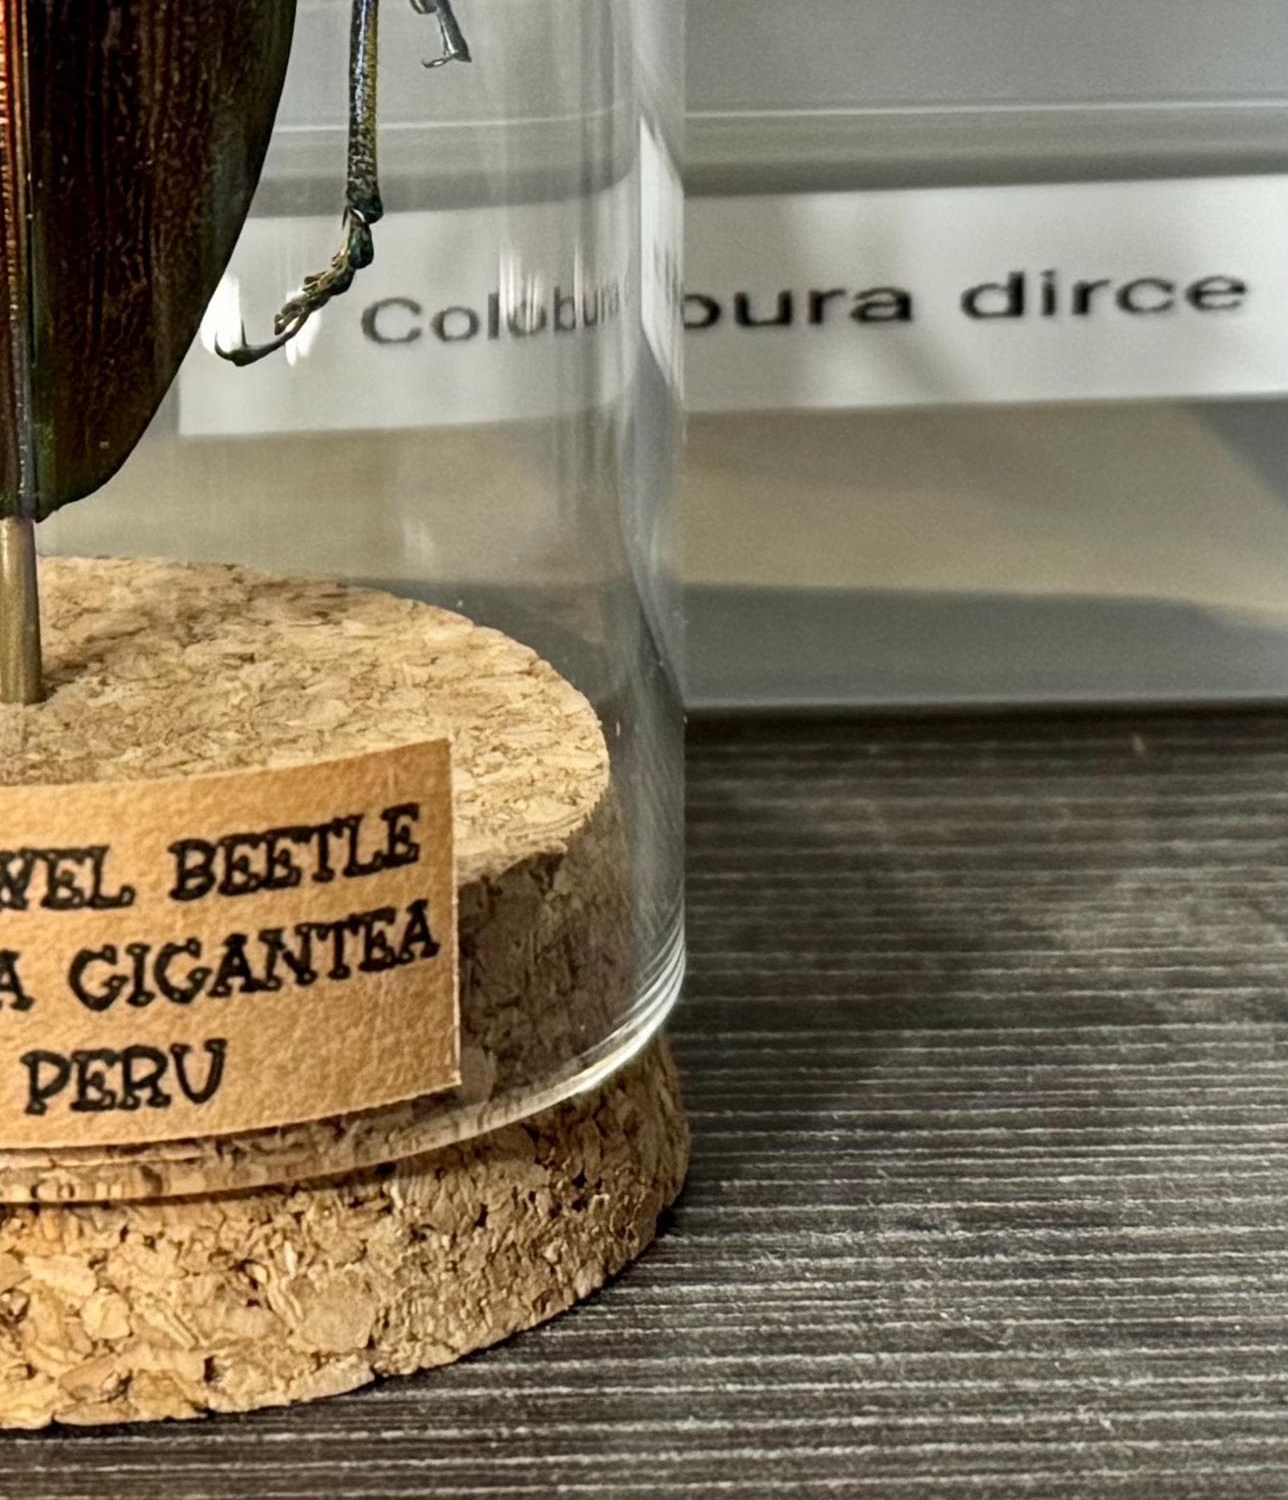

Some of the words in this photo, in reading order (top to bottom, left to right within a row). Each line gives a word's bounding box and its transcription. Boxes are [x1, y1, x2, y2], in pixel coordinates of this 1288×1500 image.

[961, 270, 1249, 322] dirce
[168, 802, 421, 902] BEETLE
[67, 900, 441, 1013] GIGANTEA
[23, 1038, 228, 1117] PERU
